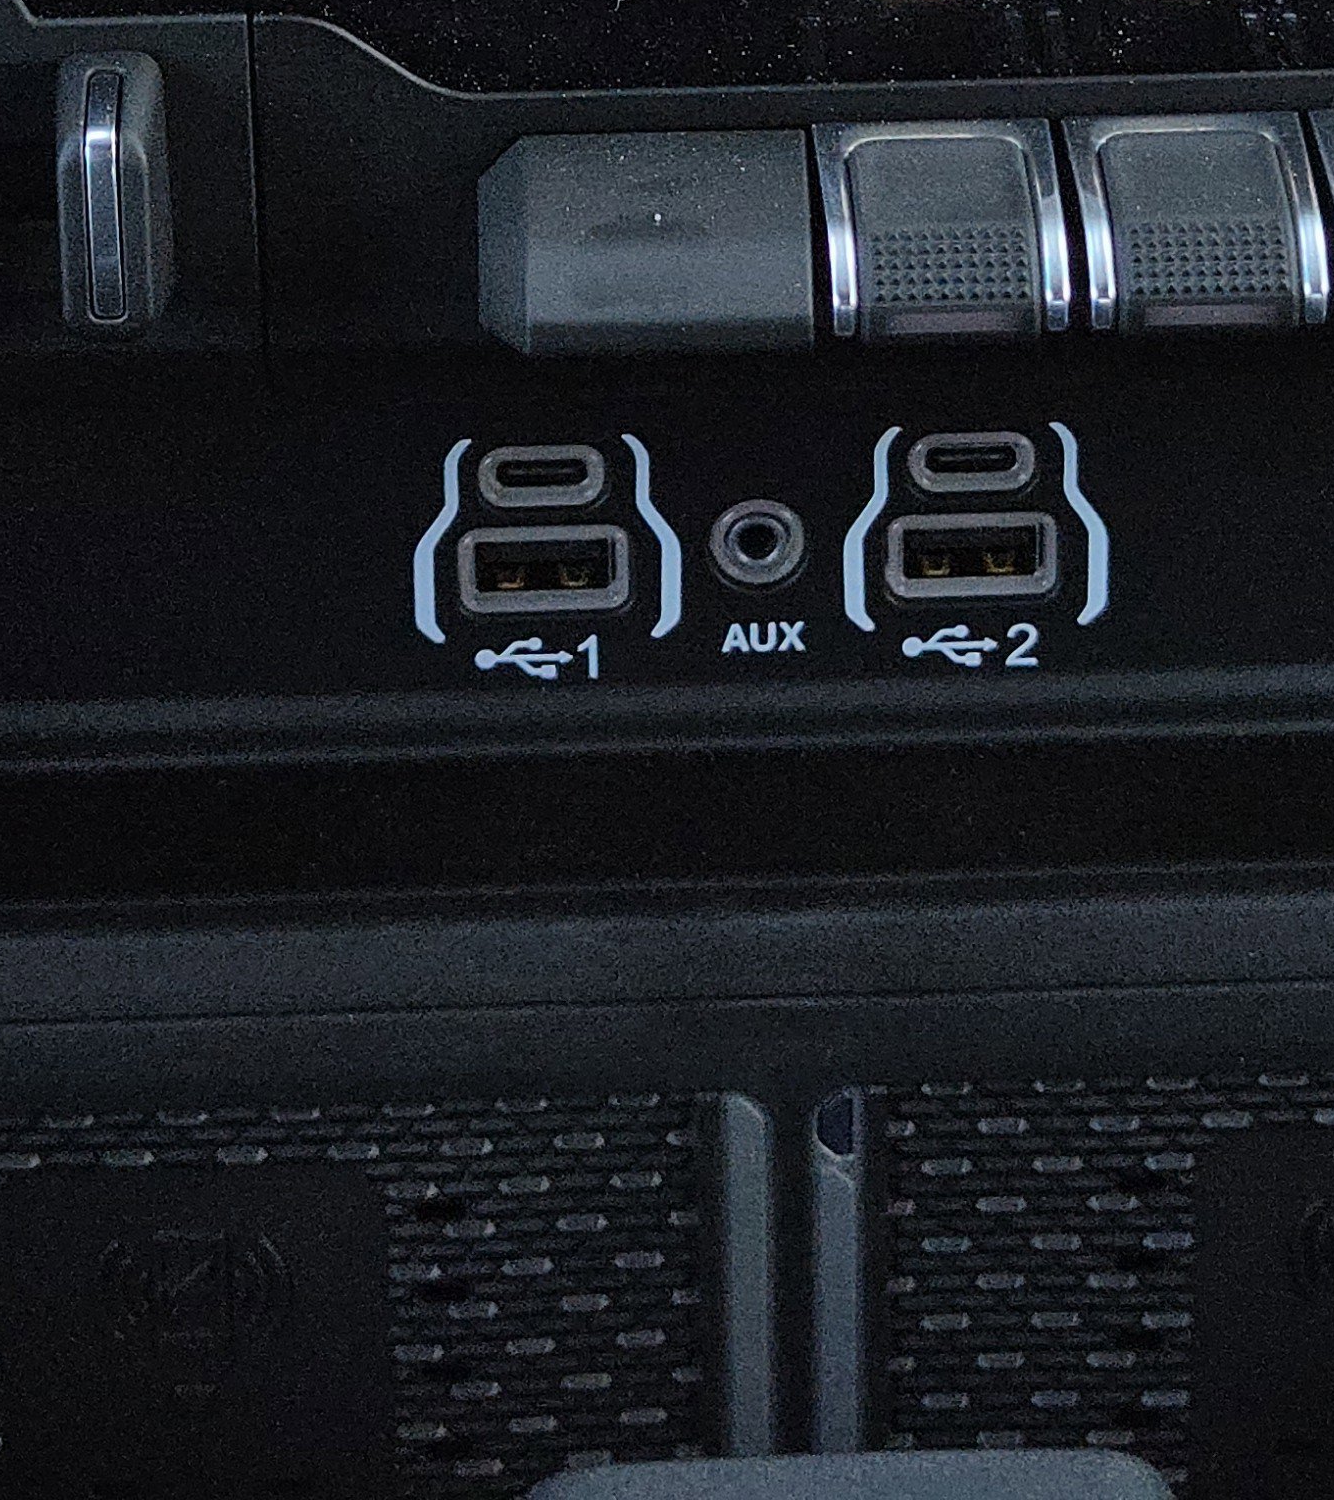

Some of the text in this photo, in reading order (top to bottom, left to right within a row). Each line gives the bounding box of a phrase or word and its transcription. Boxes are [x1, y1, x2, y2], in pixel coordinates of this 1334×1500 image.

[577, 634, 598, 679] 1
[722, 621, 805, 653] AUX
[1005, 623, 1038, 666] 2
